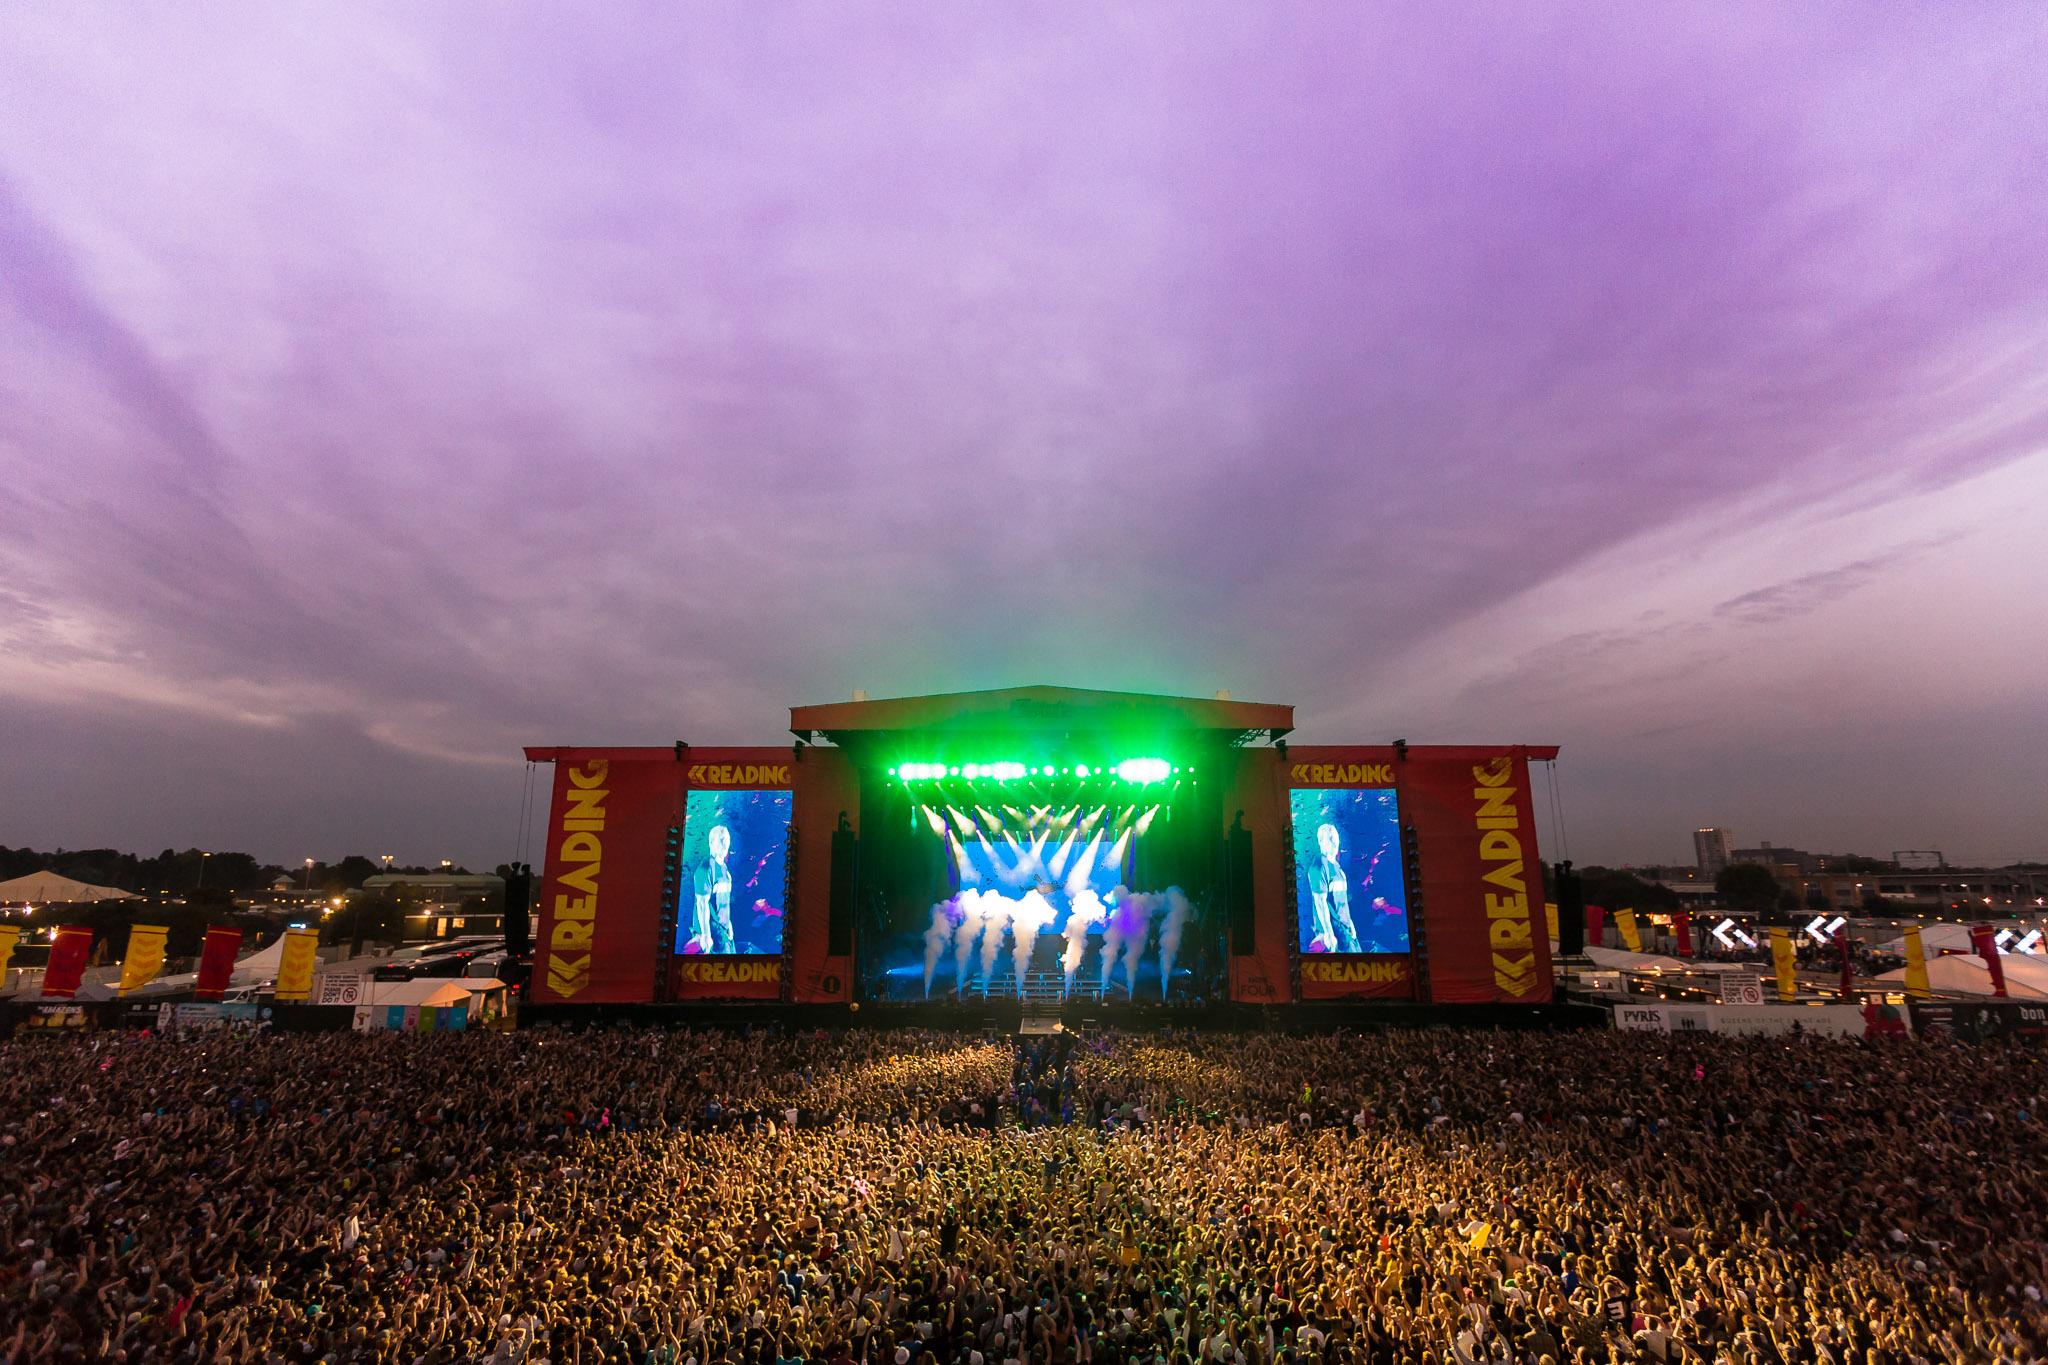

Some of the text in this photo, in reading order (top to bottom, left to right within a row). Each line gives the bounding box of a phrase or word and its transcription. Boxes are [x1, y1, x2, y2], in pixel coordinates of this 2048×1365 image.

[707, 765, 791, 785] READING
[1310, 764, 1396, 784] READING
[552, 760, 611, 950] READING
[1472, 757, 1534, 950] READING
